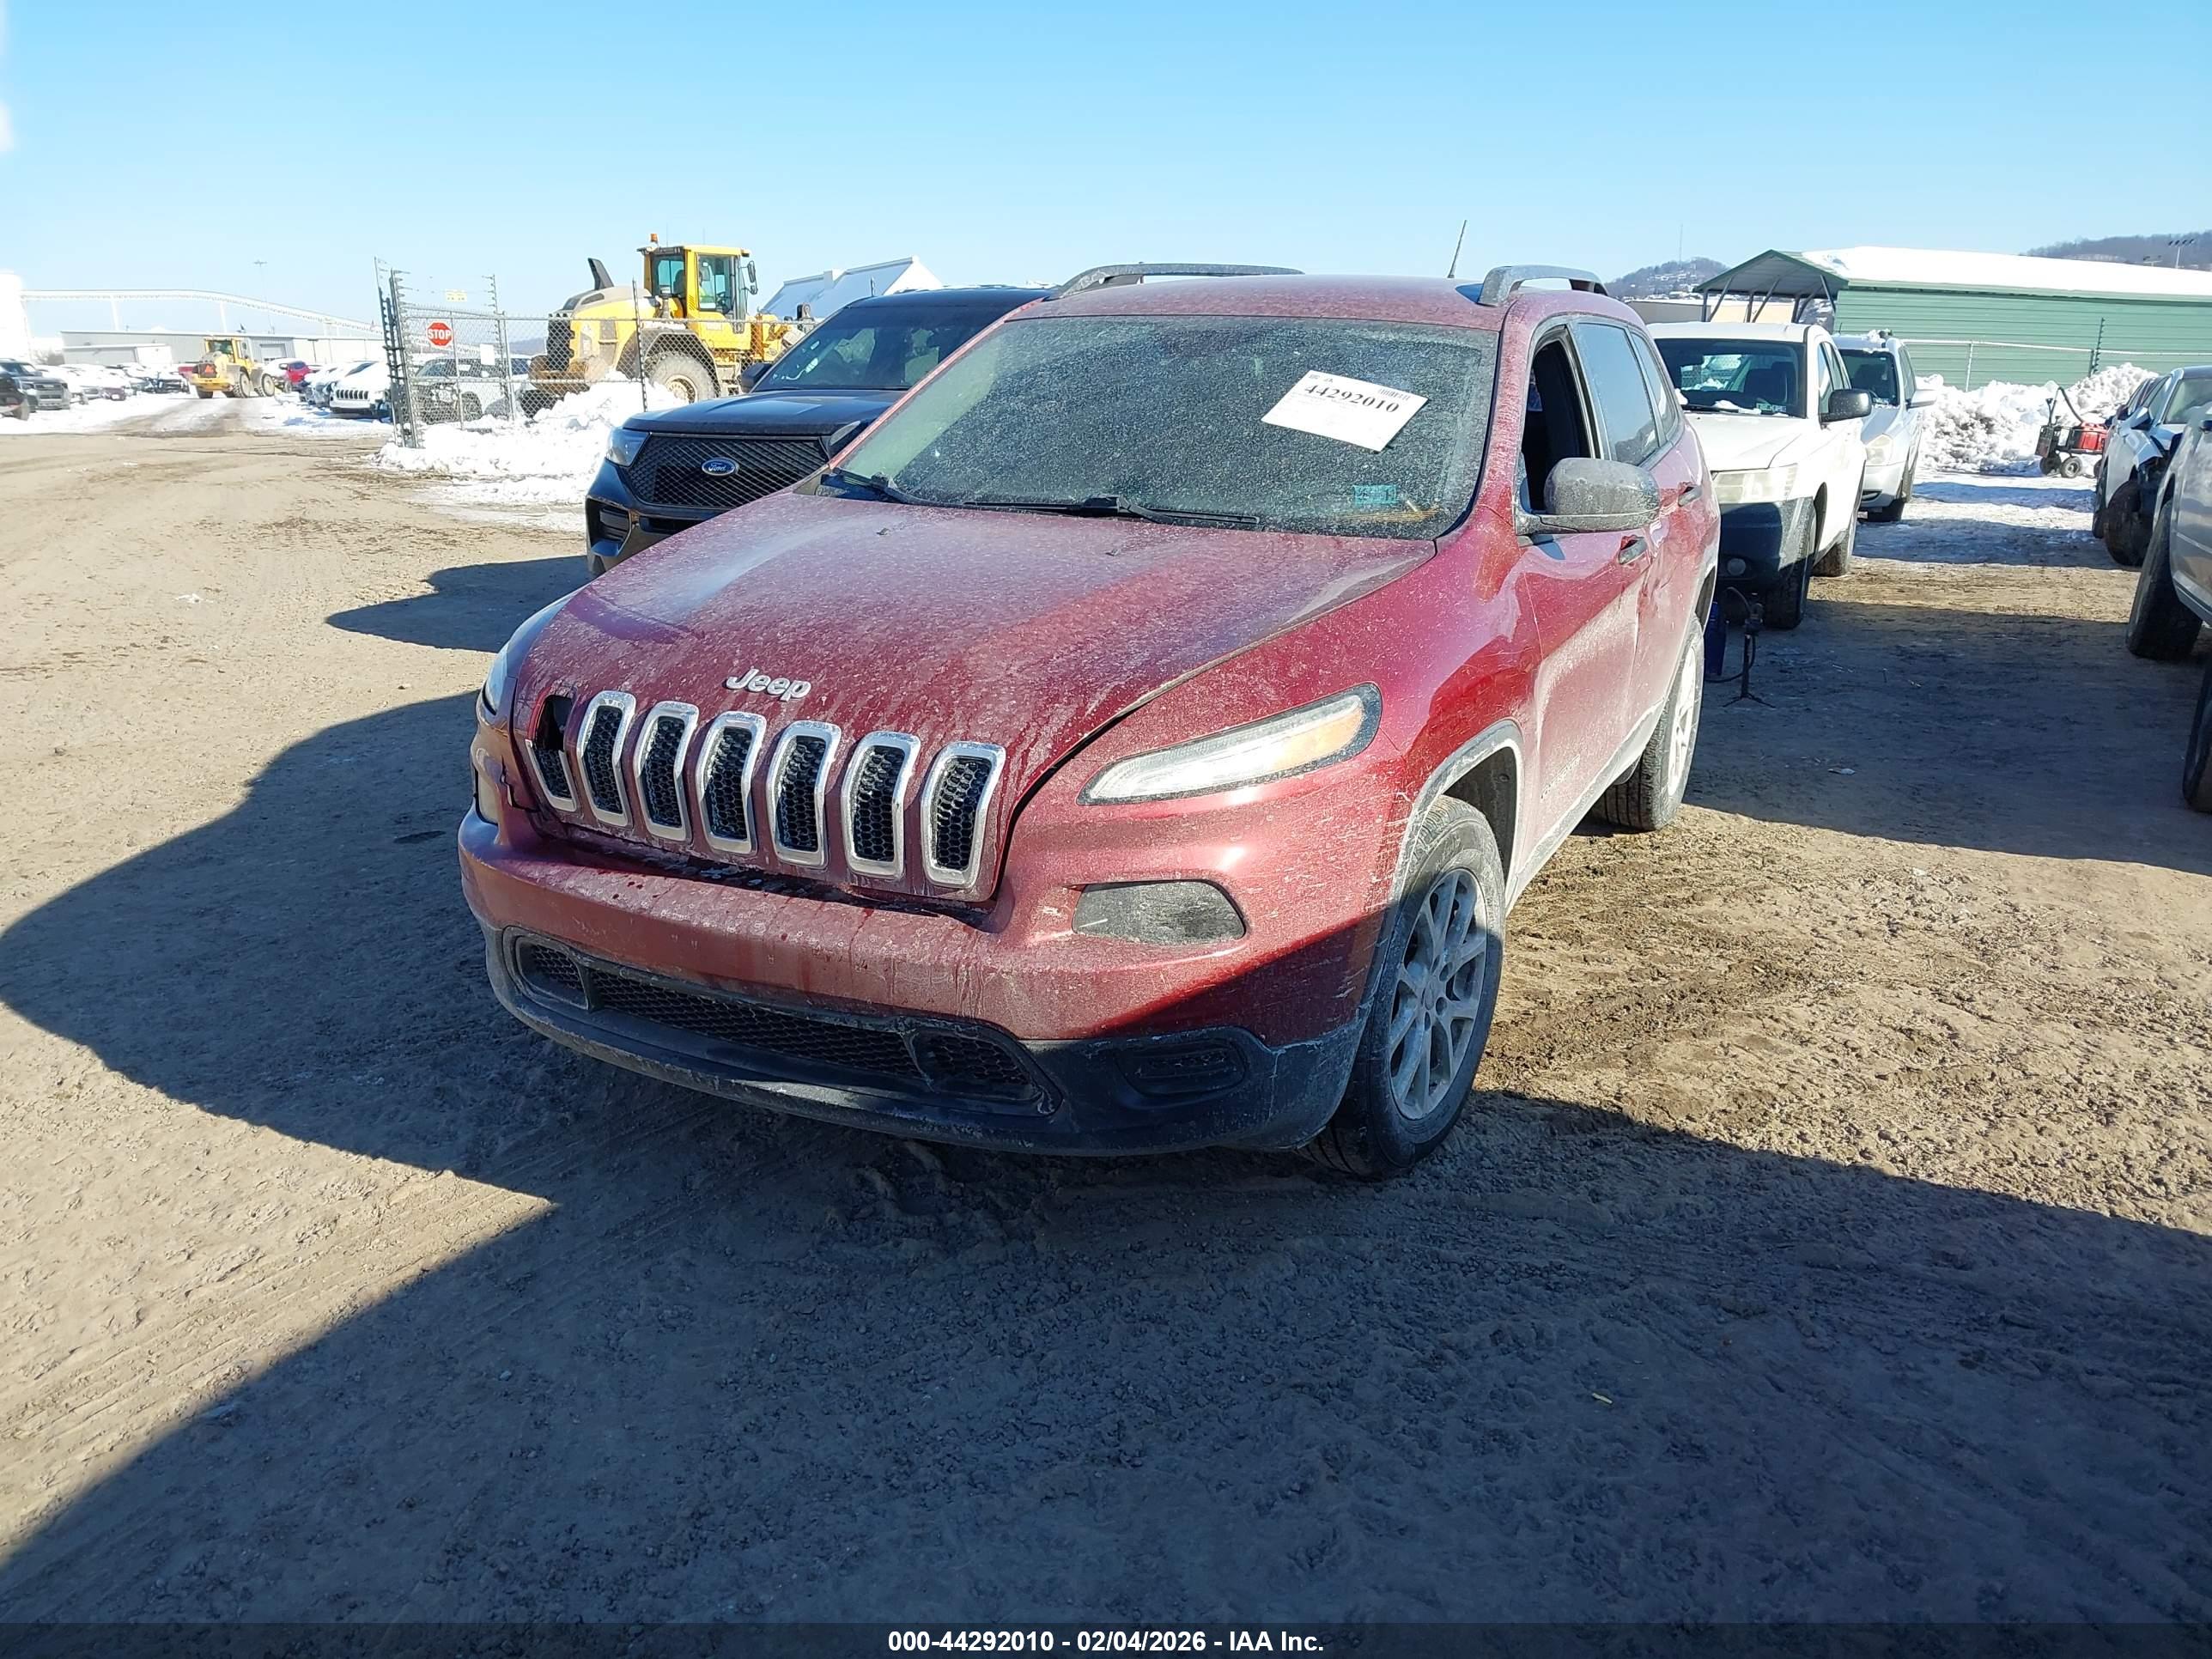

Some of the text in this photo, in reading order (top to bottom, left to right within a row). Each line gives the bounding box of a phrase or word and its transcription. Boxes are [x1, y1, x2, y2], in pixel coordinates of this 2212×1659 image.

[428, 328, 452, 340] STOP
[1304, 385, 1400, 413] 44292010
[708, 462, 727, 471] Ford
[726, 668, 811, 702] Jeep
